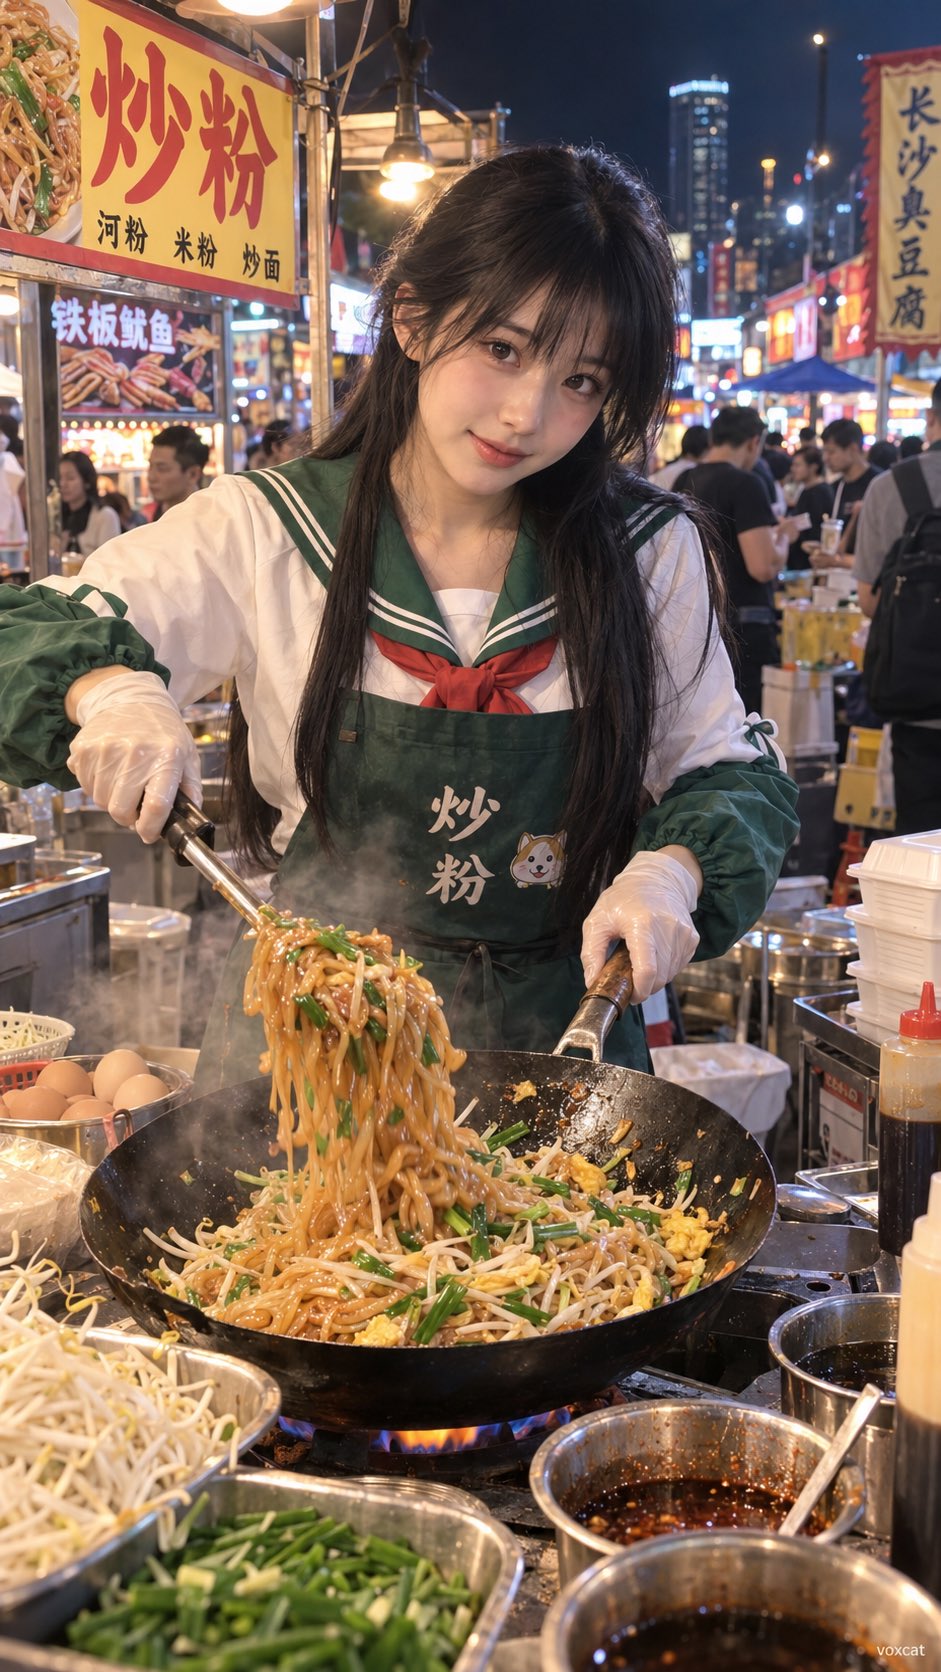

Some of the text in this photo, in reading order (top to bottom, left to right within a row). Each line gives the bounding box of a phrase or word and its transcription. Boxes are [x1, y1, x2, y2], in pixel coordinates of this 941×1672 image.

[90, 25, 278, 230] 炒粉
[97, 210, 281, 283] 河粉 米粉 炒面
[51, 296, 176, 355] 铁板鱿鱼
[425, 785, 501, 905] 炒粉
